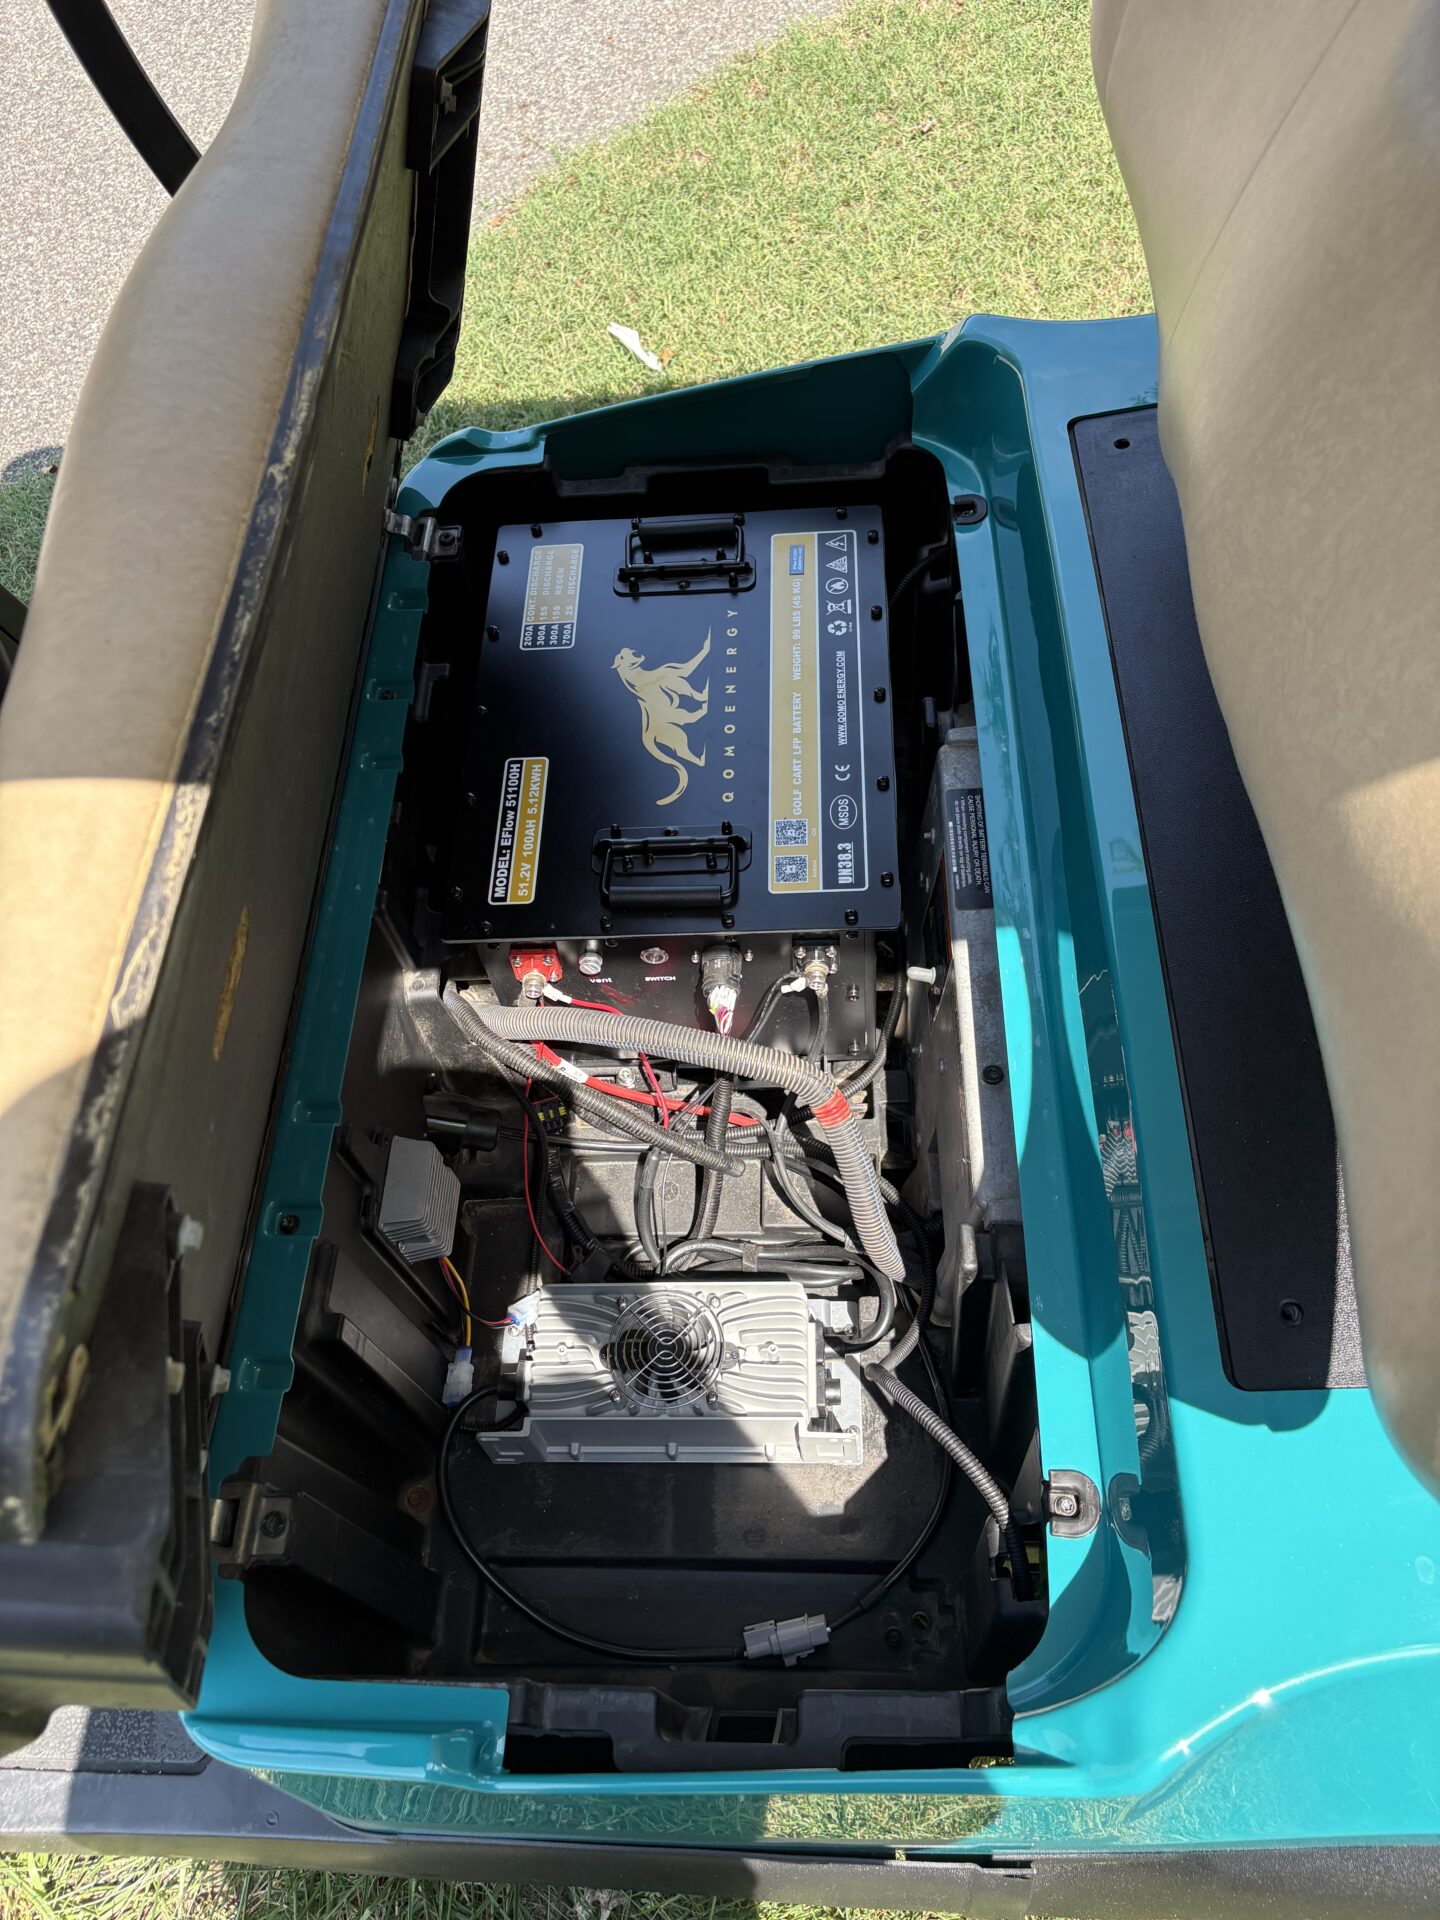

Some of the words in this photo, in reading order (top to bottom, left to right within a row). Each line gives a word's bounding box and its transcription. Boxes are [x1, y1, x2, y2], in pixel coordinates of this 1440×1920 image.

[530, 550, 542, 596] DISCHARGE
[542, 550, 554, 595] DISCHARGE
[555, 567, 565, 595] REGEN
[567, 549, 579, 595] DISCHARGE
[792, 578, 803, 593] KG)
[527, 597, 537, 622] CONT.
[540, 606, 548, 620] 15S
[553, 605, 561, 620] 15S
[565, 605, 574, 615] 2S
[792, 595, 803, 609] (45
[792, 610, 801, 627] LBS
[524, 625, 533, 646] 200A
[537, 625, 546, 645] 300A
[550, 624, 559, 645] 300A
[562, 624, 572, 644] 700A
[792, 630, 801, 640] 99
[792, 643, 801, 681] WEIGHT:
[722, 610, 738, 803] QOMOENERGY
[792, 691, 802, 734] BATTERY
[793, 737, 802, 755] LFP
[793, 759, 802, 785] CART
[506, 764, 520, 807] 51100H
[528, 764, 542, 814] 5.12KWH
[793, 789, 802, 816] GOLF
[838, 798, 849, 826] MSDS
[967, 795, 975, 812] CAUSE
[975, 794, 983, 820] SHORTING
[501, 811, 515, 846] EFlow
[970, 812, 978, 840] PERSONAL
[977, 821, 984, 829] OF
[523, 820, 536, 857] 100AH
[972, 840, 980, 858] INJURY
[494, 850, 510, 898] MODEL:
[837, 842, 853, 884] UN38.3
[973, 858, 980, 867] OR
[980, 852, 989, 881] TERMINALS
[518, 863, 531, 896] 51.2V
